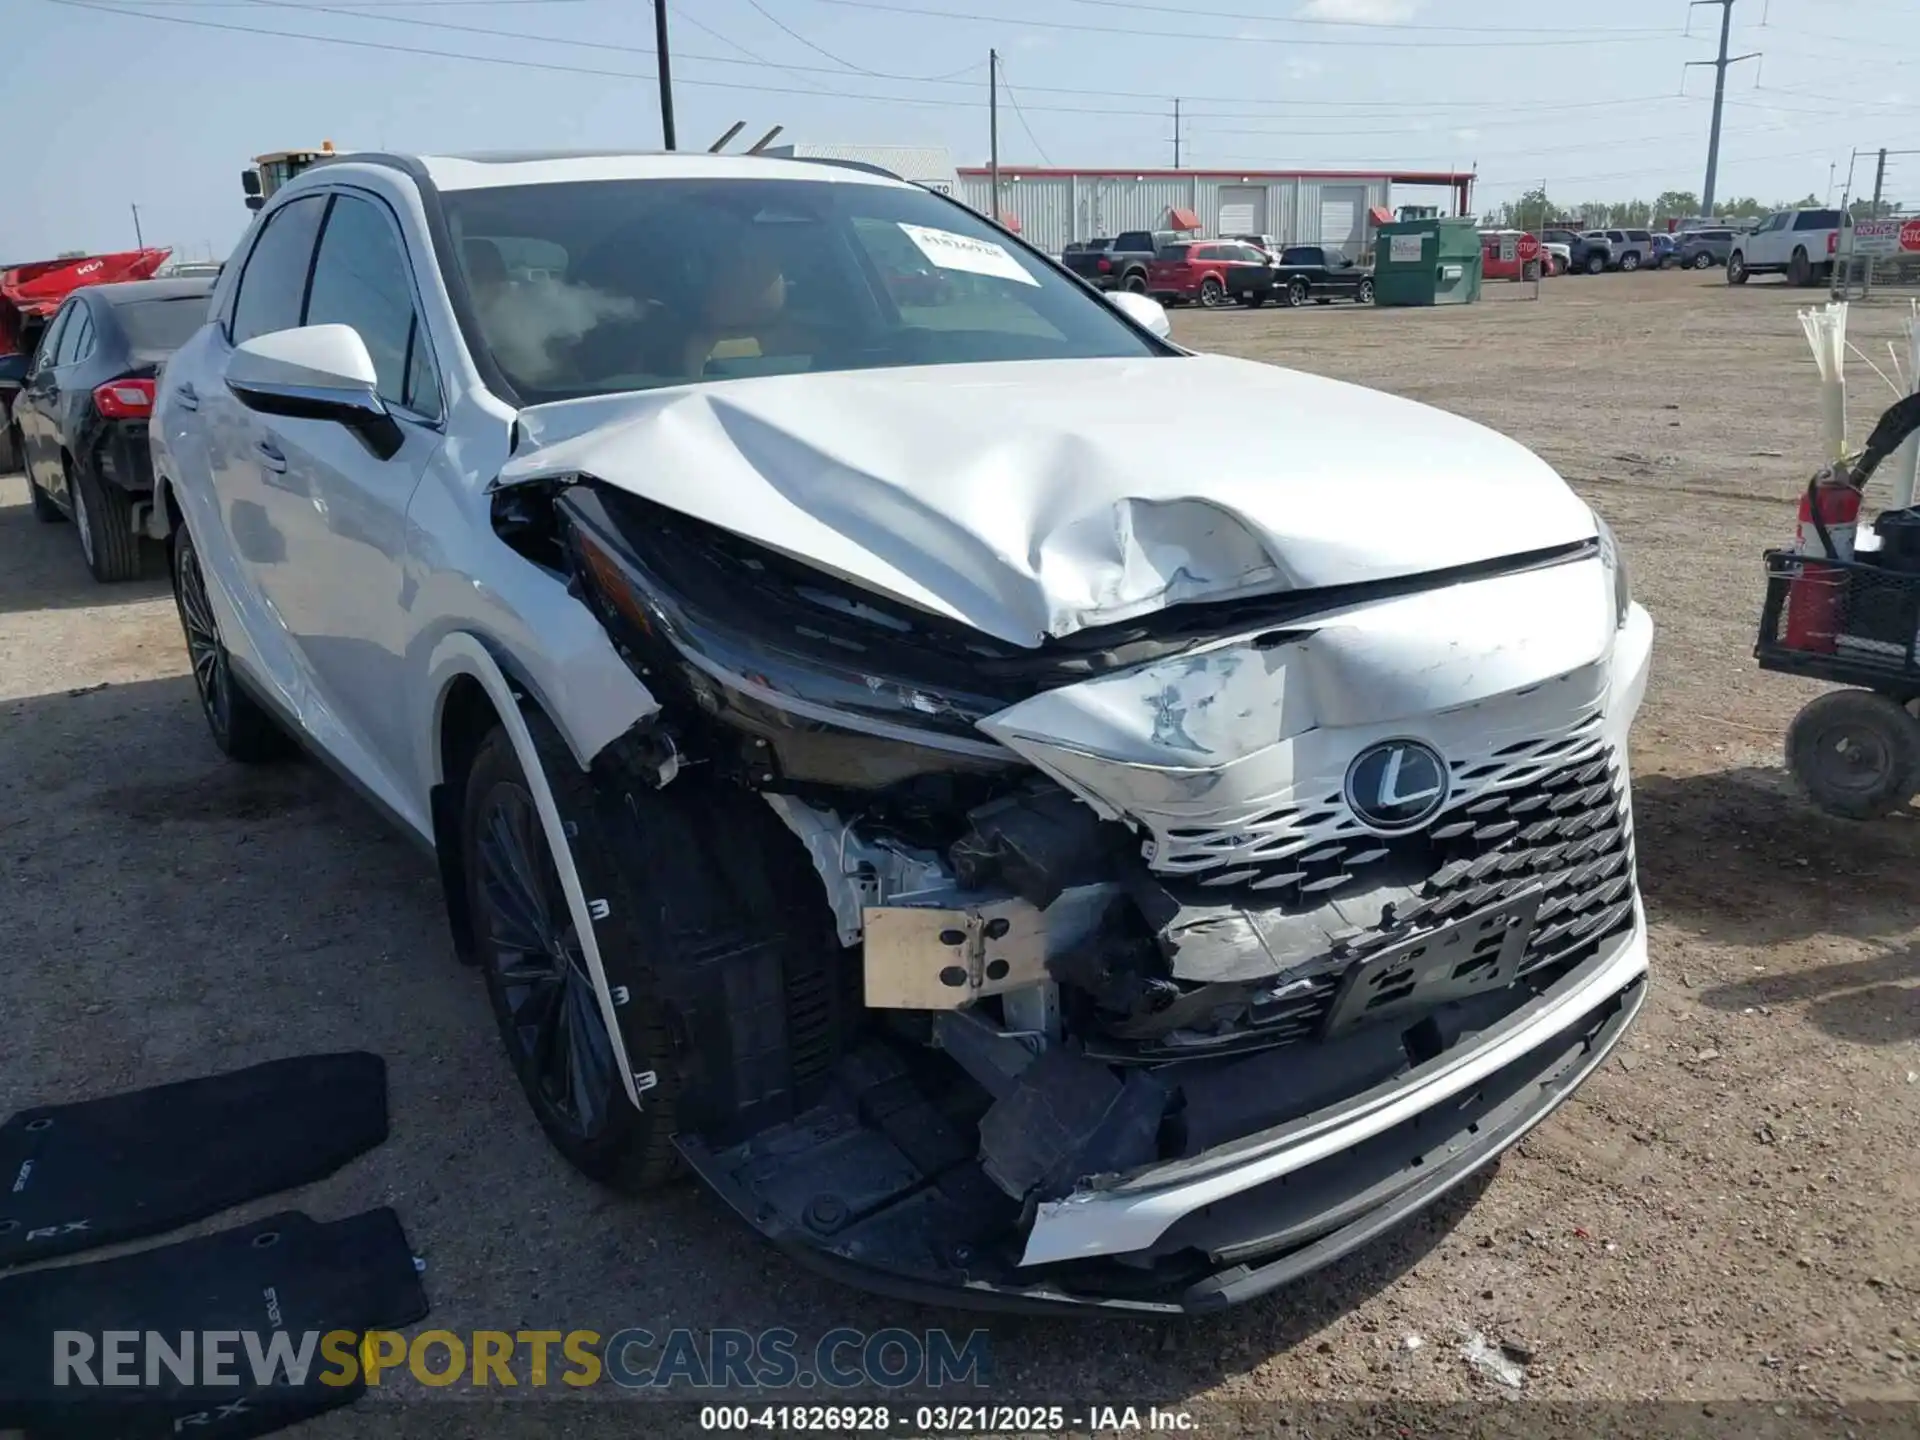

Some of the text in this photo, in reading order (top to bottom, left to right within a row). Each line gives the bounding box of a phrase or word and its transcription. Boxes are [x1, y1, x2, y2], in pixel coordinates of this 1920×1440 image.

[1856, 223, 1897, 235] NOTICE
[1902, 229, 1920, 242] STO
[1518, 242, 1537, 252] STOP
[1504, 251, 1513, 260] 15
[26, 1217, 91, 1241] RX
[174, 1398, 250, 1433] RX
